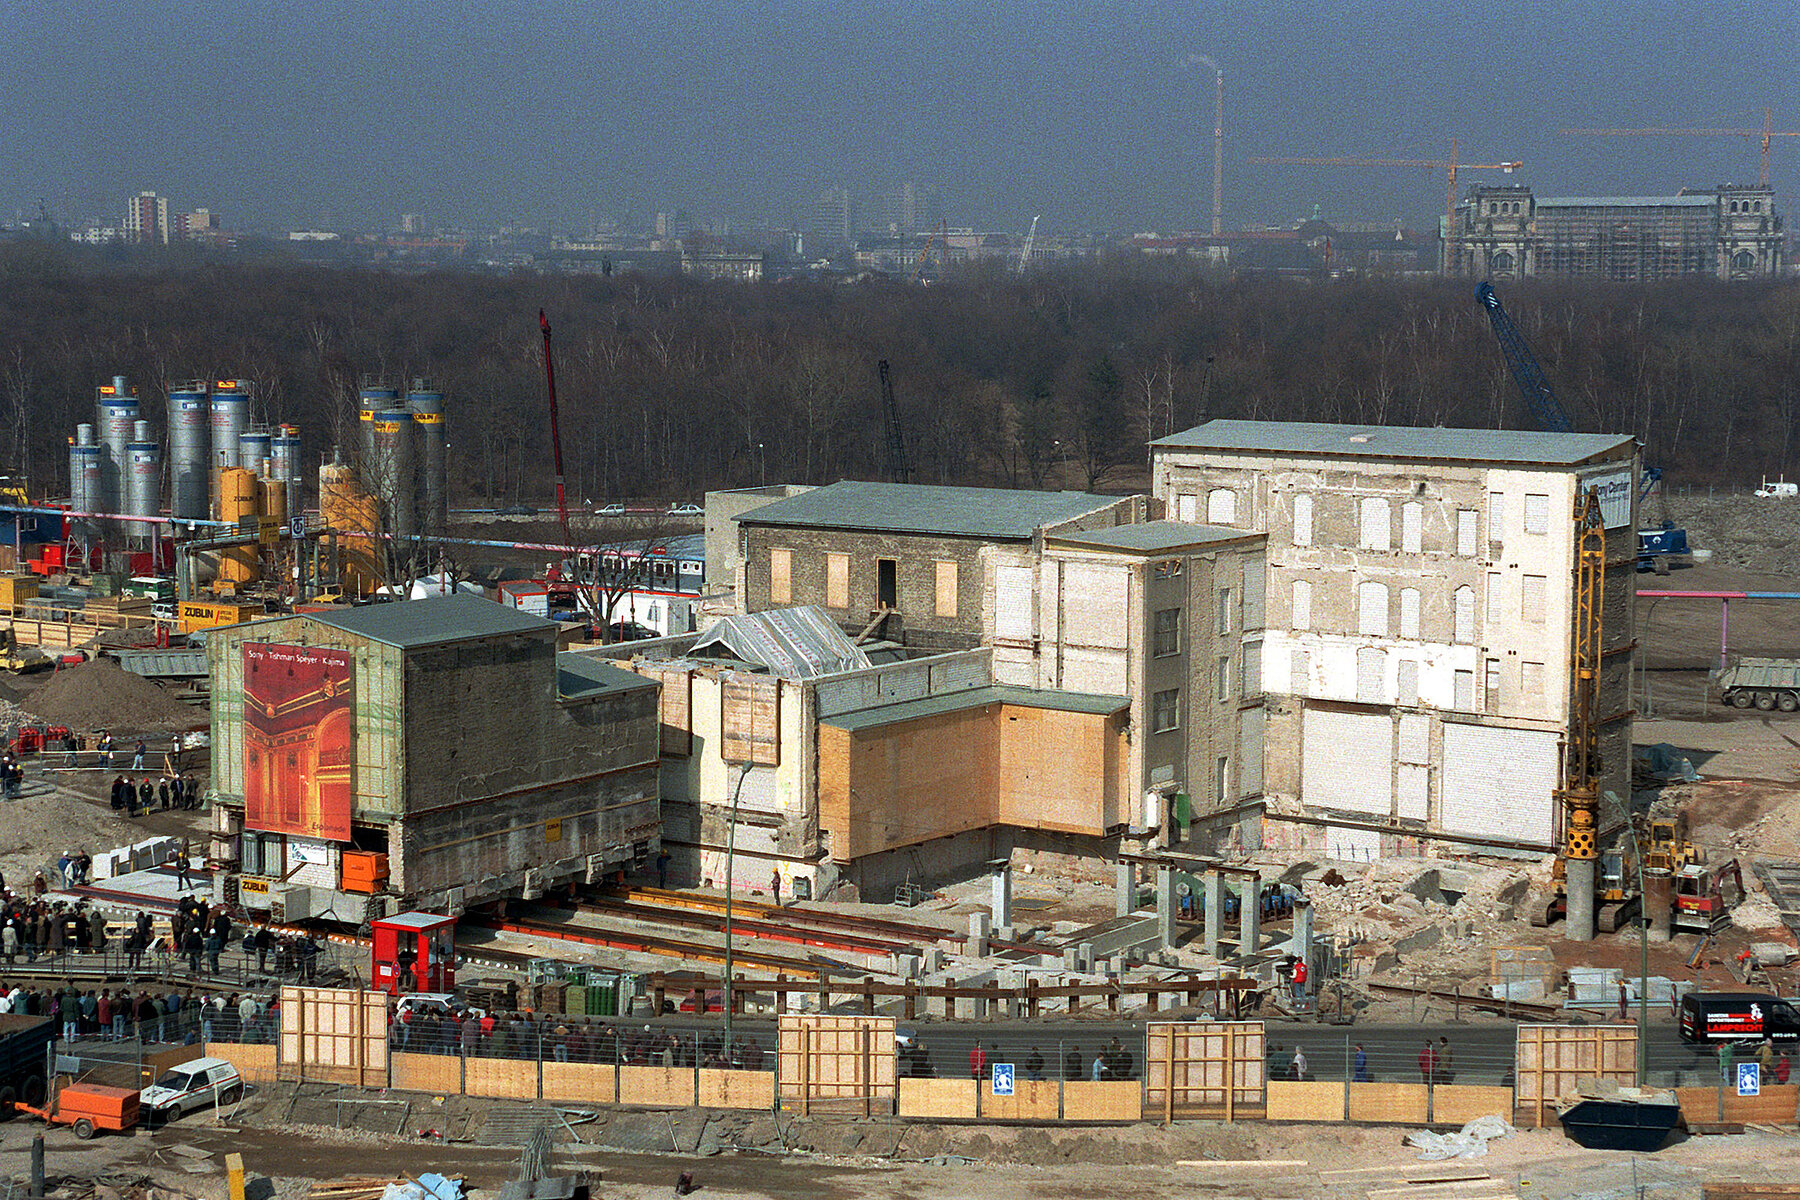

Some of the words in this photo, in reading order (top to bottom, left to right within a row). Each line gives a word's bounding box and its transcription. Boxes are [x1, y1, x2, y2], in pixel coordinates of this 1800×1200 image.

[248, 650, 264, 660] Sony
[269, 652, 295, 662] Tishman
[296, 654, 318, 664] Speyer
[1707, 1023, 1763, 1032] LAMPRECHT
